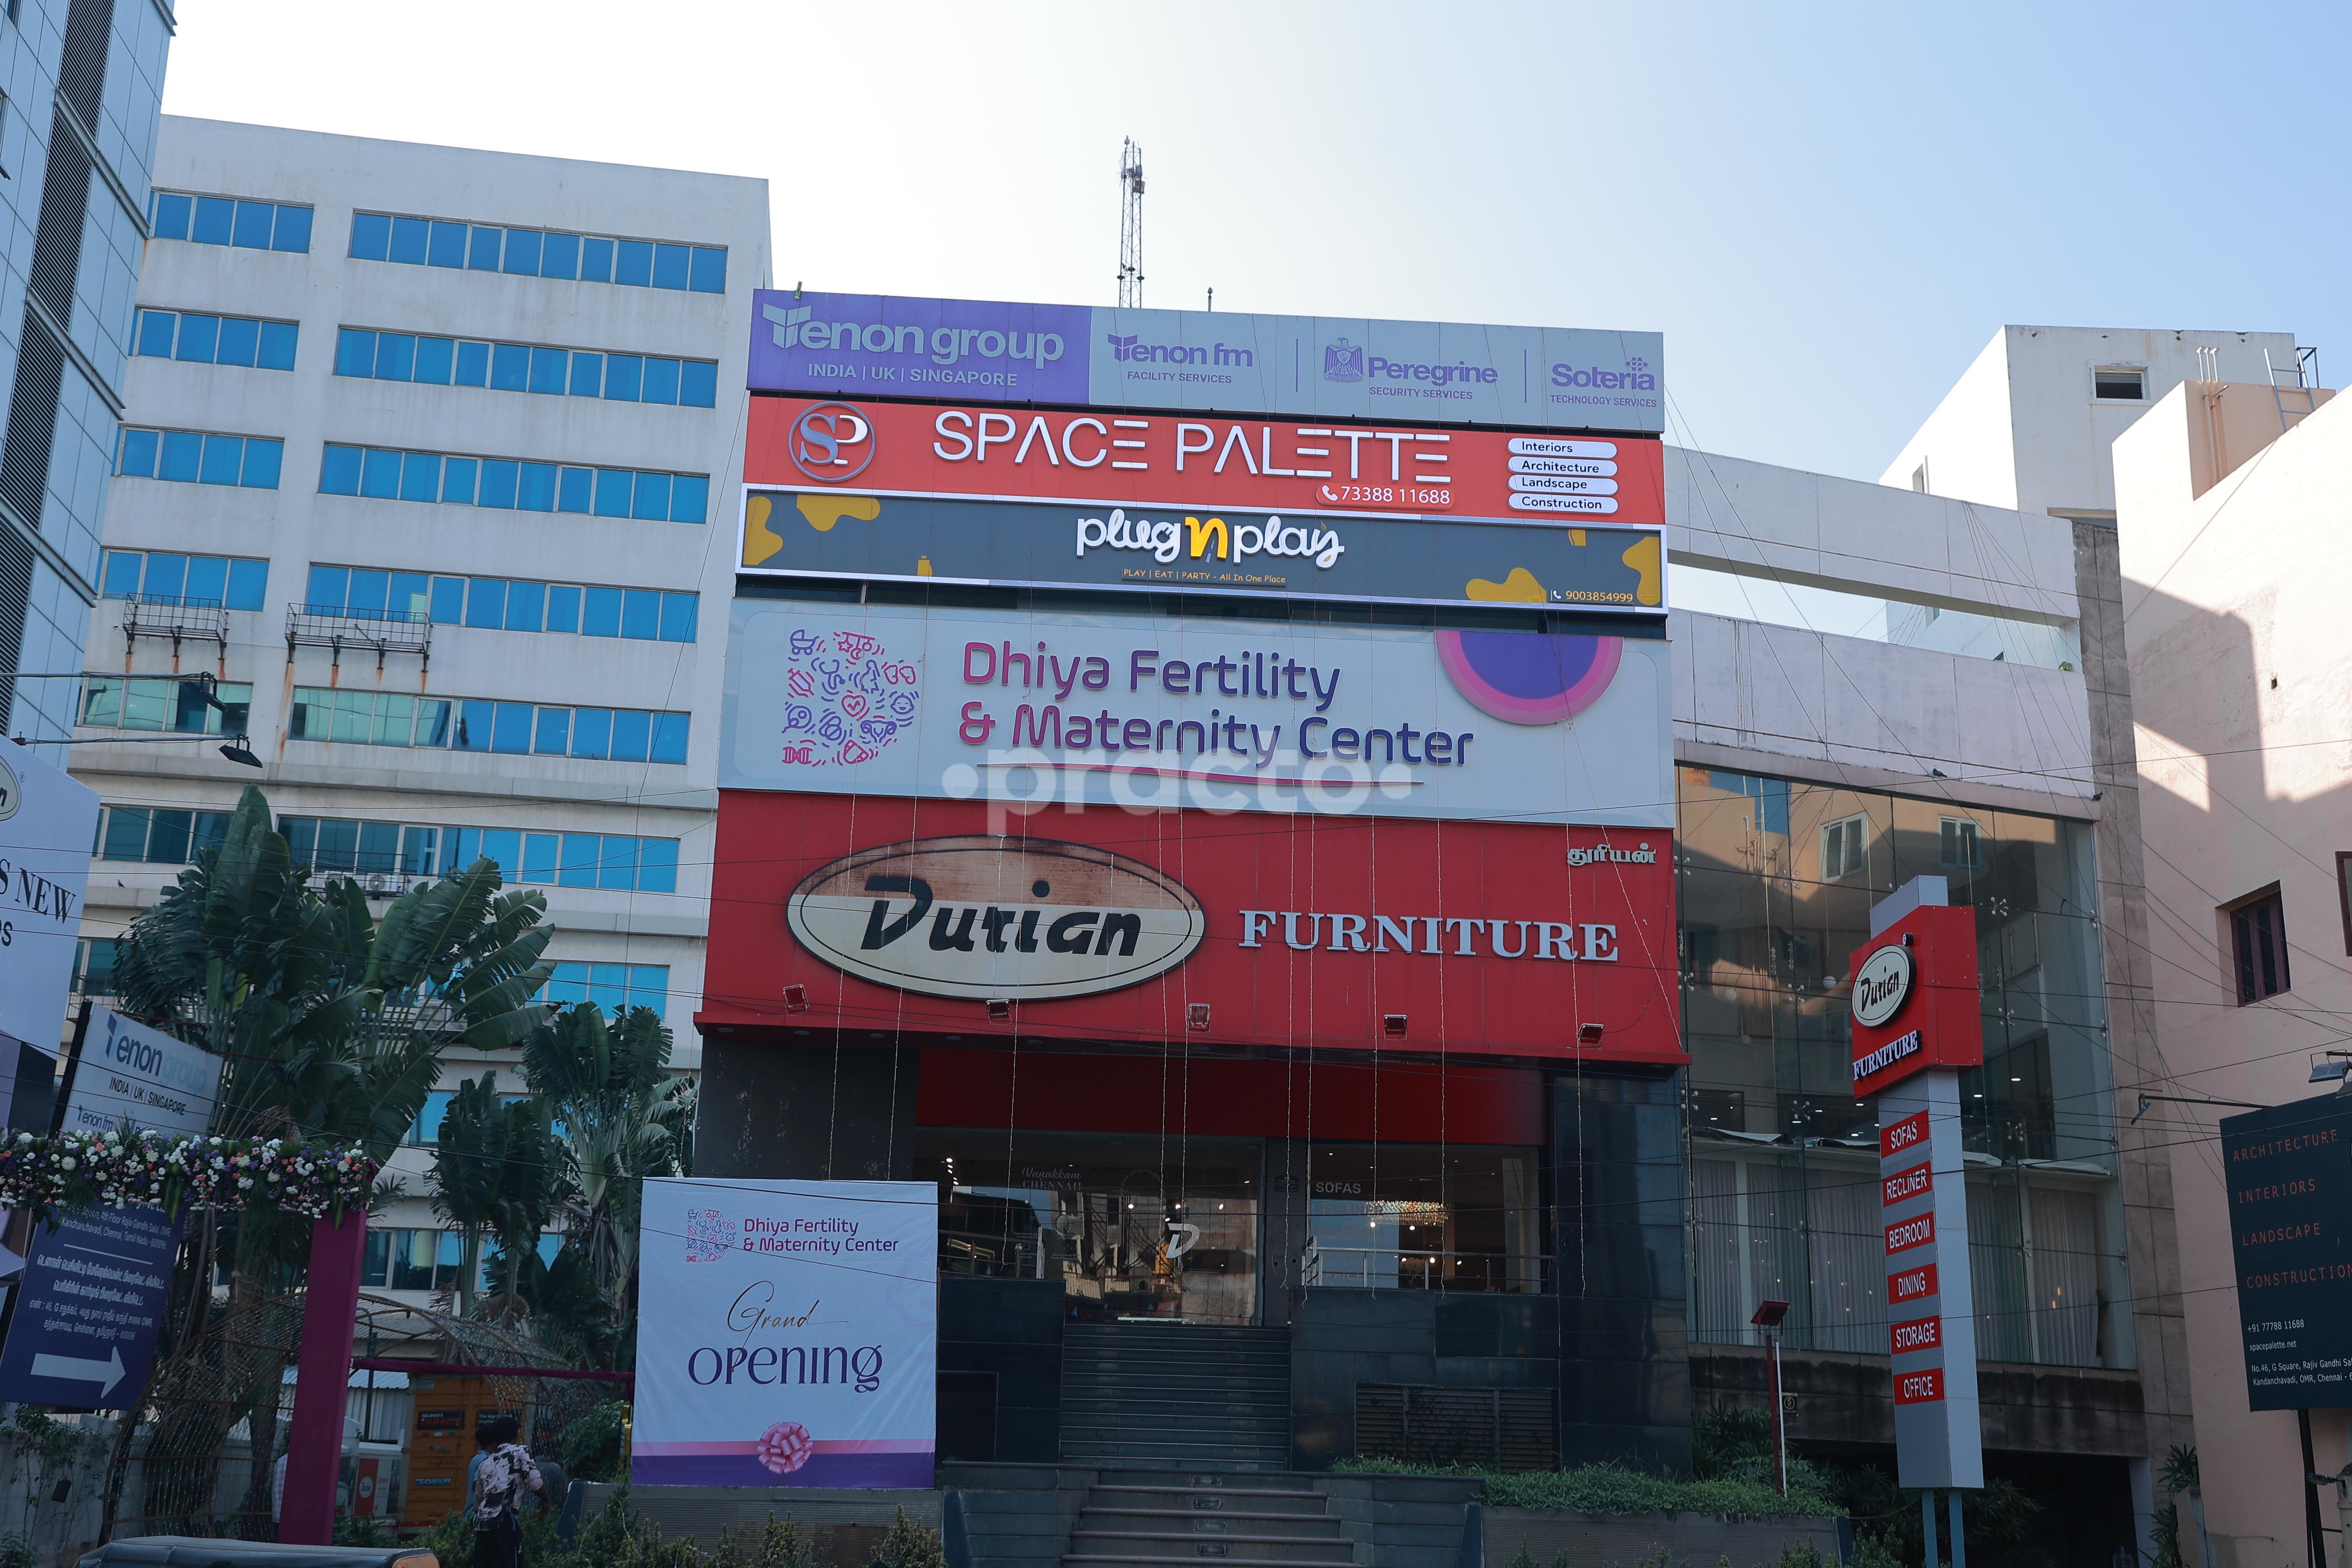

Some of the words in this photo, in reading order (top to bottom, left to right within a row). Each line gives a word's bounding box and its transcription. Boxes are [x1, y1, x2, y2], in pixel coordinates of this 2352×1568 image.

[931, 328, 1064, 370] group
[1108, 333, 1207, 367] Tenon
[1214, 343, 1253, 367] fm
[808, 363, 857, 379] INDIA
[872, 367, 895, 381] UK
[910, 368, 1017, 386] SINGAPORE
[1127, 371, 1176, 382] FACILITY
[1179, 373, 1232, 384] SERVICES
[1368, 356, 1498, 386] Peregrine
[1551, 357, 1655, 391] Soteria
[1369, 387, 1420, 397] SECURITY
[1423, 389, 1473, 400] SERVICES
[1550, 395, 1611, 406] TECHNOLOGY
[1614, 397, 1657, 407] SERVICES
[934, 410, 1148, 470] SPACE
[1176, 423, 1451, 484] PALETTE
[1522, 441, 1573, 453] Interiors
[1522, 460, 1599, 473] Architecture
[1341, 486, 1393, 502] 73388
[1400, 488, 1450, 504] 11688
[1522, 477, 1587, 490] Landscape
[1522, 496, 1602, 509] Construction
[1076, 509, 1181, 564] plug
[1124, 569, 1146, 577] PLAY
[1155, 570, 1173, 578] EAT
[1182, 572, 1210, 580] PARTY
[1246, 574, 1262, 582] One
[1265, 575, 1286, 583] Place
[1565, 591, 1633, 602] 9003854999
[963, 640, 1110, 701] Dhiya
[1130, 650, 1340, 712] Fertility
[959, 701, 995, 745] &
[1012, 704, 1281, 769] Maternity
[1298, 717, 1473, 765] Center
[15, 867, 77, 925] NEW
[861, 876, 1141, 957] Durian
[1239, 910, 1618, 962] FURNITURE
[1860, 966, 1899, 1012] Durian
[1853, 1030, 1918, 1081] FURNITURE
[161, 1054, 208, 1095] group
[109, 1077, 129, 1096] INDIA
[133, 1087, 145, 1101] UK
[148, 1091, 187, 1116] SINGAPORE
[1891, 1121, 1917, 1149] SOFAS
[2234, 1129, 2338, 1162] ARCHITECTURE
[1022, 1167, 1082, 1179] Vanakkam
[1886, 1169, 1927, 1200] RECLINER
[1023, 1180, 1081, 1191] CHENNAI!
[1316, 1182, 1361, 1193] SOFAS
[2239, 1179, 2316, 1204] INTERIORS
[744, 1219, 790, 1236] Dhiya
[794, 1219, 859, 1236] Fertility
[1315, 1226, 1384, 1238] BEDROOM
[1889, 1219, 1930, 1249] BEDROOM
[2242, 1223, 2321, 1246] LANDSCAPE
[743, 1237, 754, 1251] &
[759, 1237, 841, 1255] Maternity
[845, 1238, 899, 1252] Center
[1898, 1272, 1925, 1296] DINING
[2247, 1264, 2352, 1289] CONSTRUCTION
[1896, 1322, 1935, 1348] STORAGE
[2248, 1324, 2260, 1332] +91
[2262, 1321, 2282, 1331] 77788
[2284, 1319, 2304, 1329] 11688
[2250, 1340, 2297, 1352] spacepalette.net
[2252, 1364, 2270, 1373] No.46,
[2272, 1363, 2277, 1371] G
[2278, 1362, 2301, 1372] Square,
[2303, 1360, 2318, 1370] Rajiv
[2320, 1359, 2341, 1368] Gandhi
[1904, 1376, 1933, 1398] OFFICE
[2253, 1375, 2298, 1386] Kandanchavadi,
[2300, 1375, 2316, 1384] OMR,
[2318, 1373, 2342, 1382] Chennai
